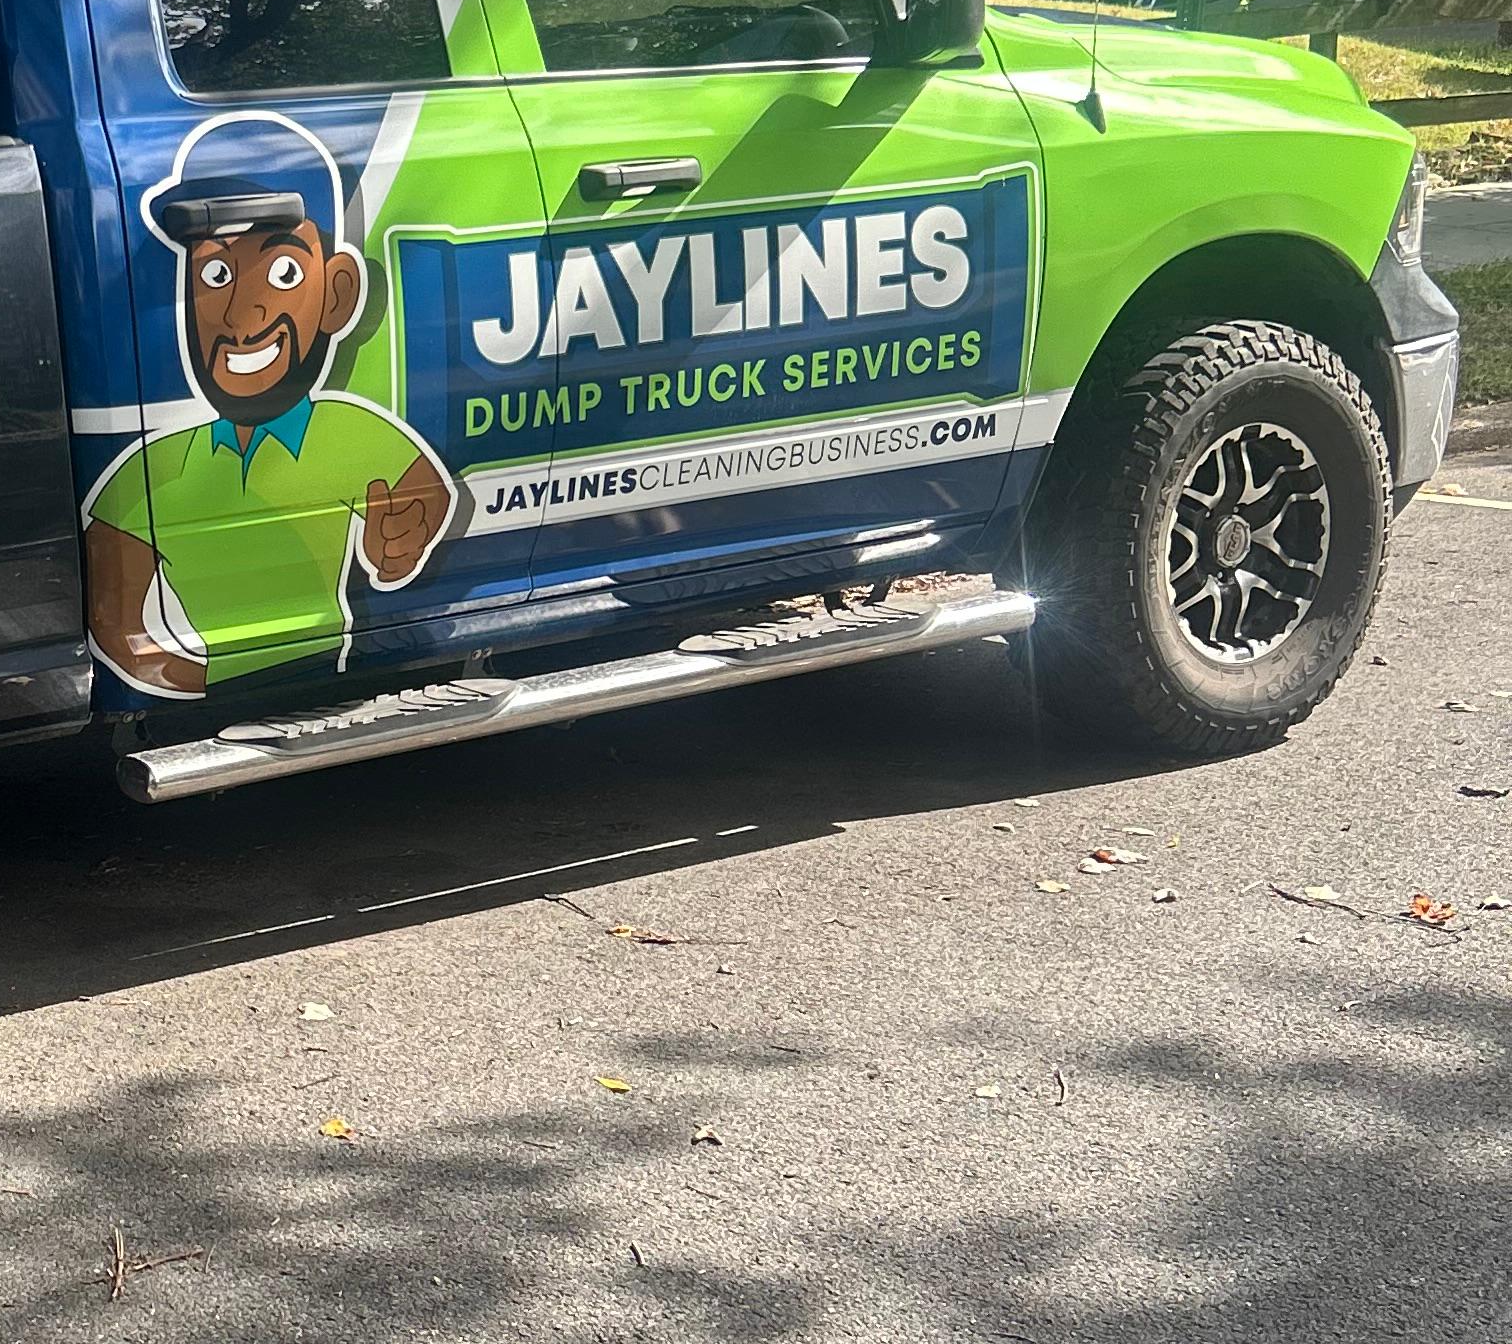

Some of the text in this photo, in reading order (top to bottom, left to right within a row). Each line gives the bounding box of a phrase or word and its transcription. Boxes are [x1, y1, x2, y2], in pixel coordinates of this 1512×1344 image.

[471, 203, 971, 367] JAYLINES
[464, 329, 983, 439] DUMP TRUCK SERVICES
[484, 412, 998, 516] JAYLINESCLEANINGBUSINESS.COM
